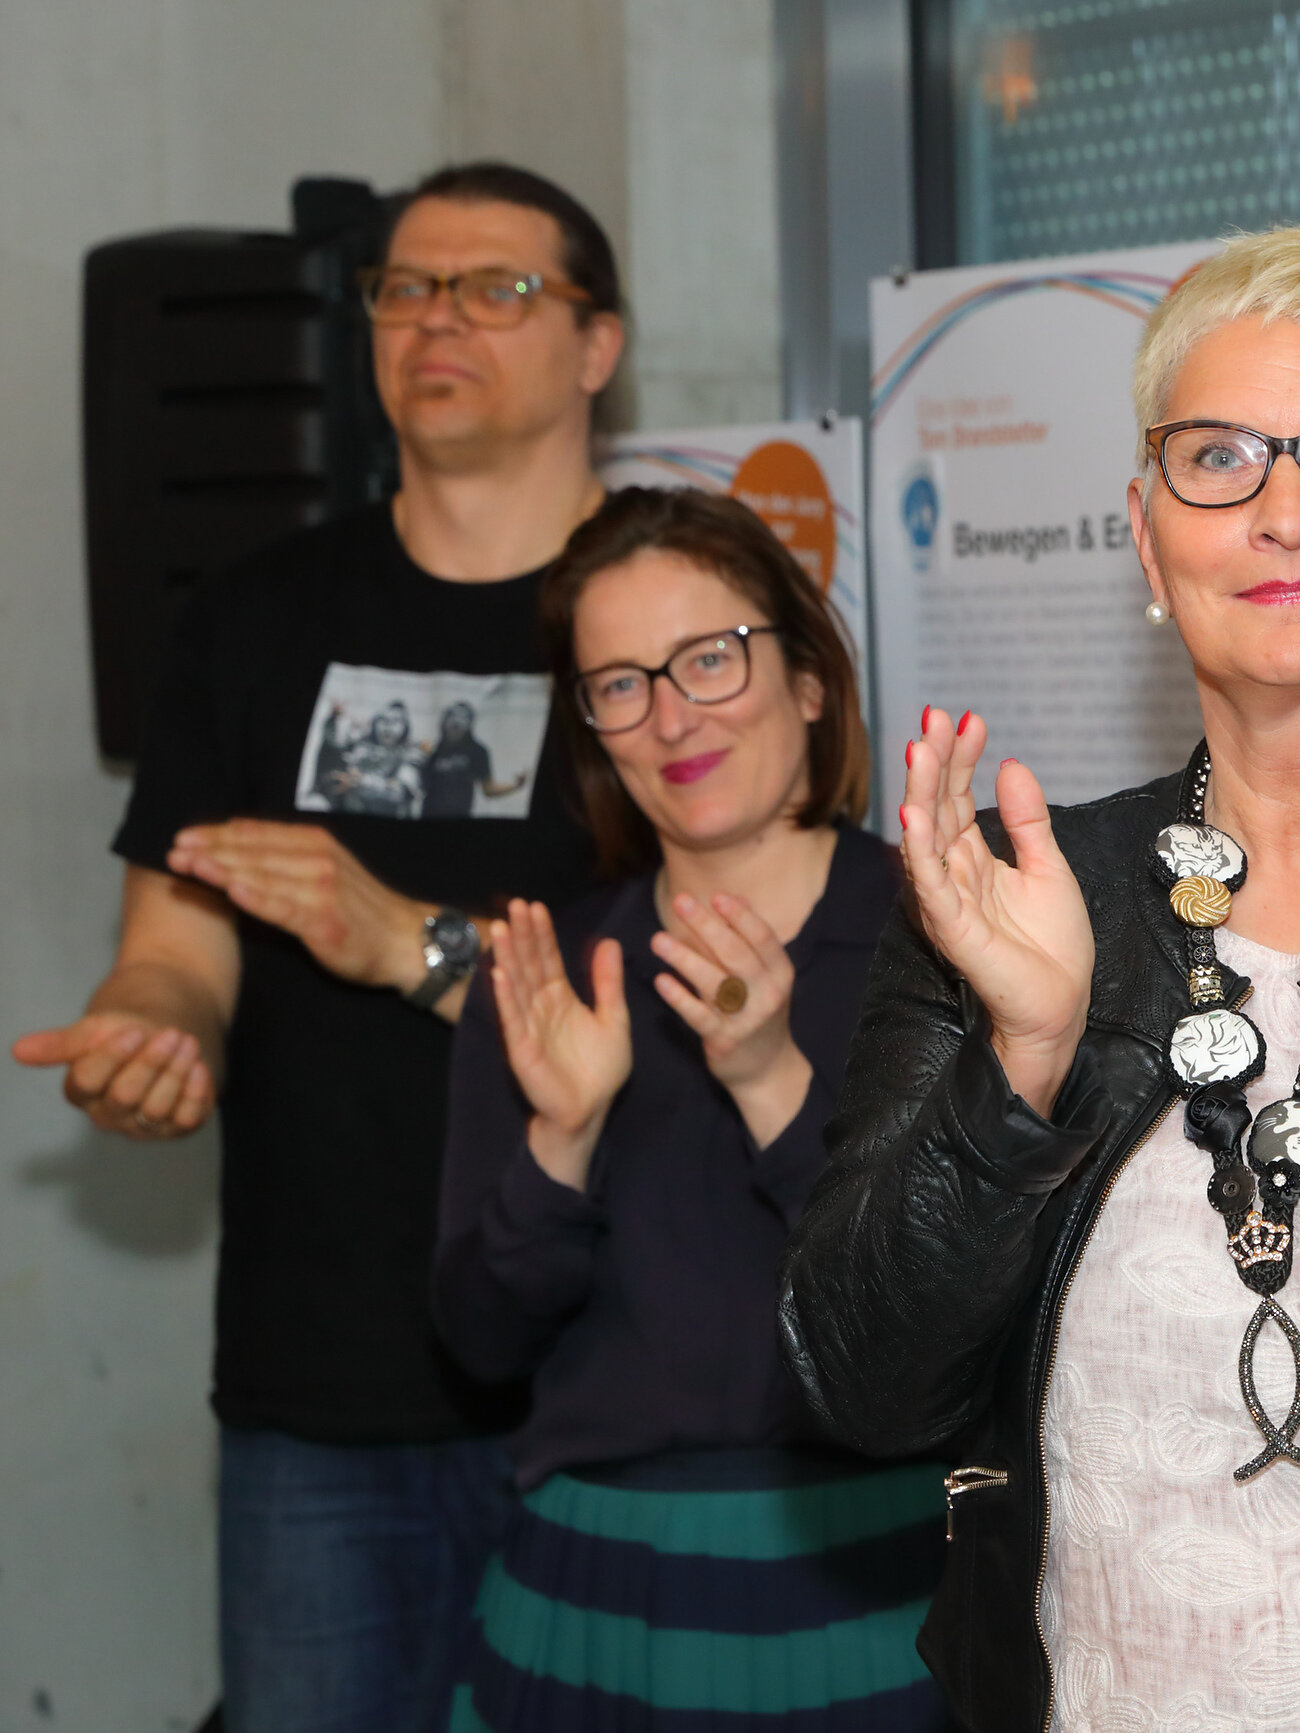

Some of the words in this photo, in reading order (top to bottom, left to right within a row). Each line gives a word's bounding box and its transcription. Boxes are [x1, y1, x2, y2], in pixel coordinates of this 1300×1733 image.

[953, 521, 1071, 563] Bewegen
[1077, 514, 1096, 551] &
[1103, 513, 1133, 549] Er
